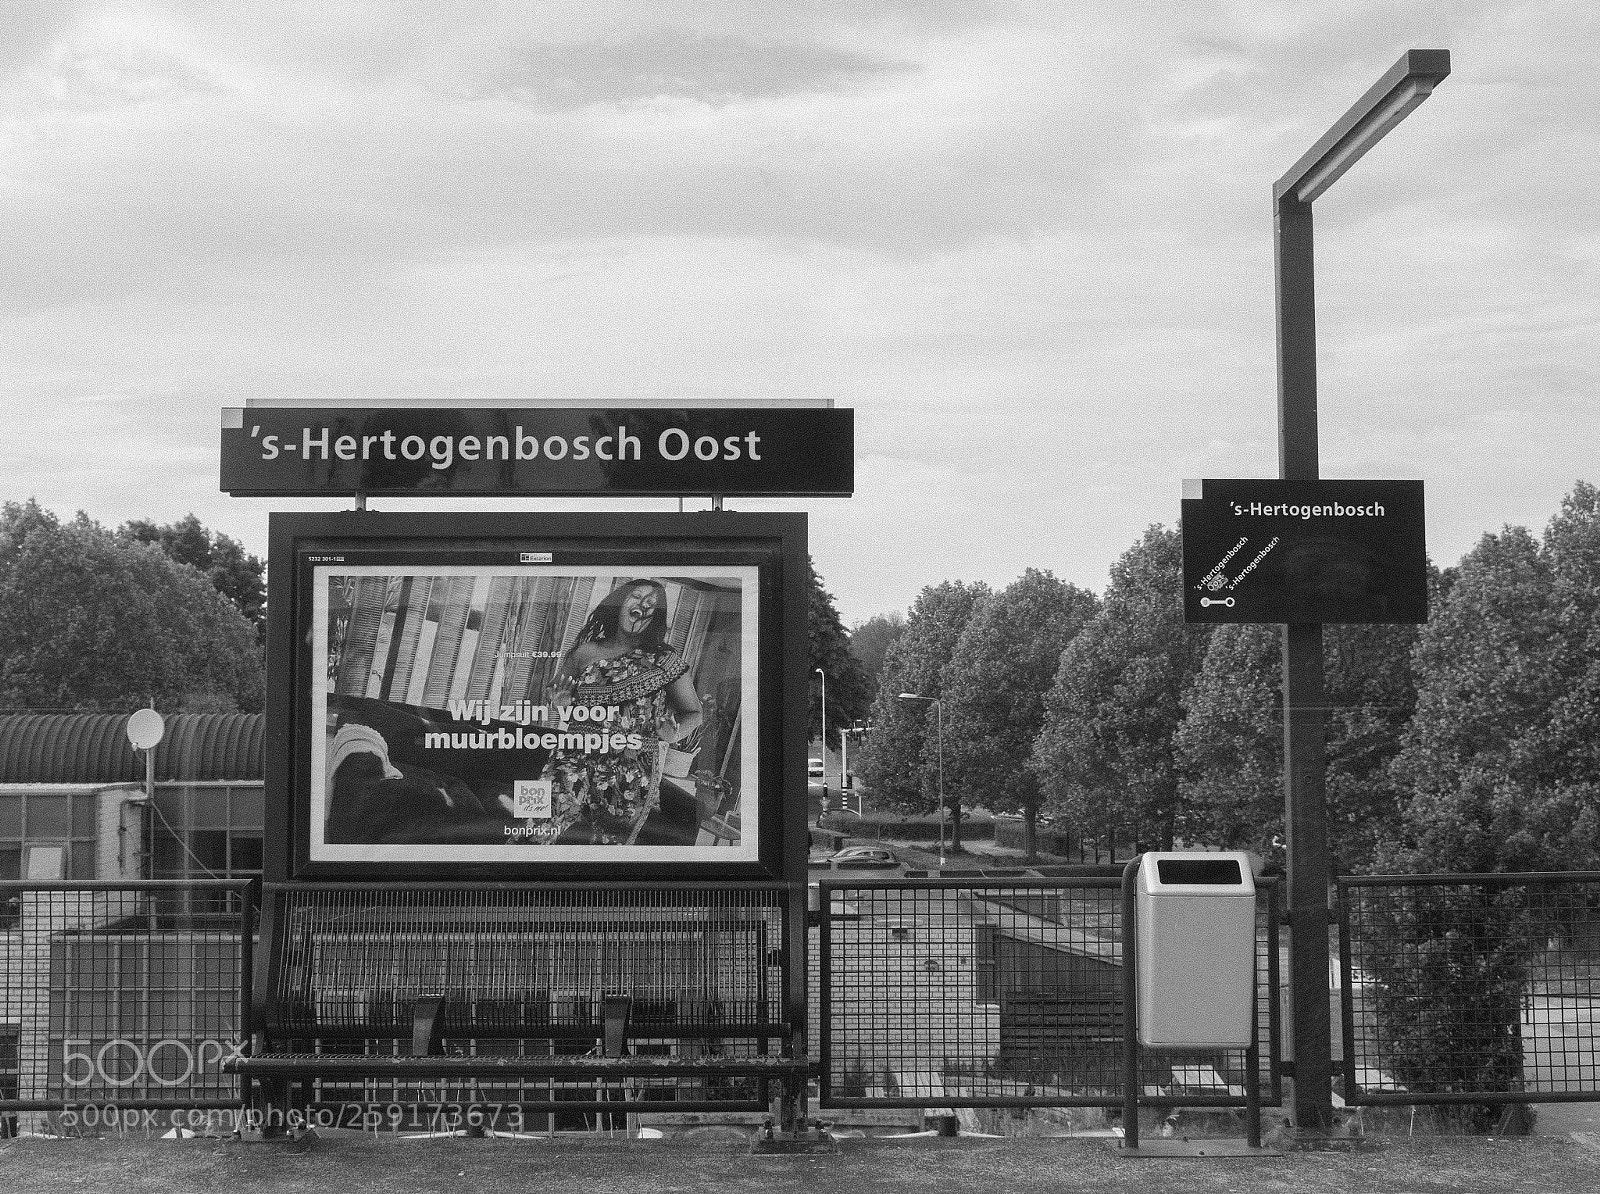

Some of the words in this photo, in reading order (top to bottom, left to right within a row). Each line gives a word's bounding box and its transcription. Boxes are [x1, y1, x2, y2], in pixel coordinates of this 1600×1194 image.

[658, 428, 761, 461] Oost
[450, 700, 491, 726] Wij
[500, 700, 548, 726] zijn
[557, 705, 619, 722] voor
[425, 728, 643, 754] muurbloempjes
[520, 785, 545, 796] bon
[519, 796, 543, 806] prix
[504, 825, 561, 837] bonprix.nl
